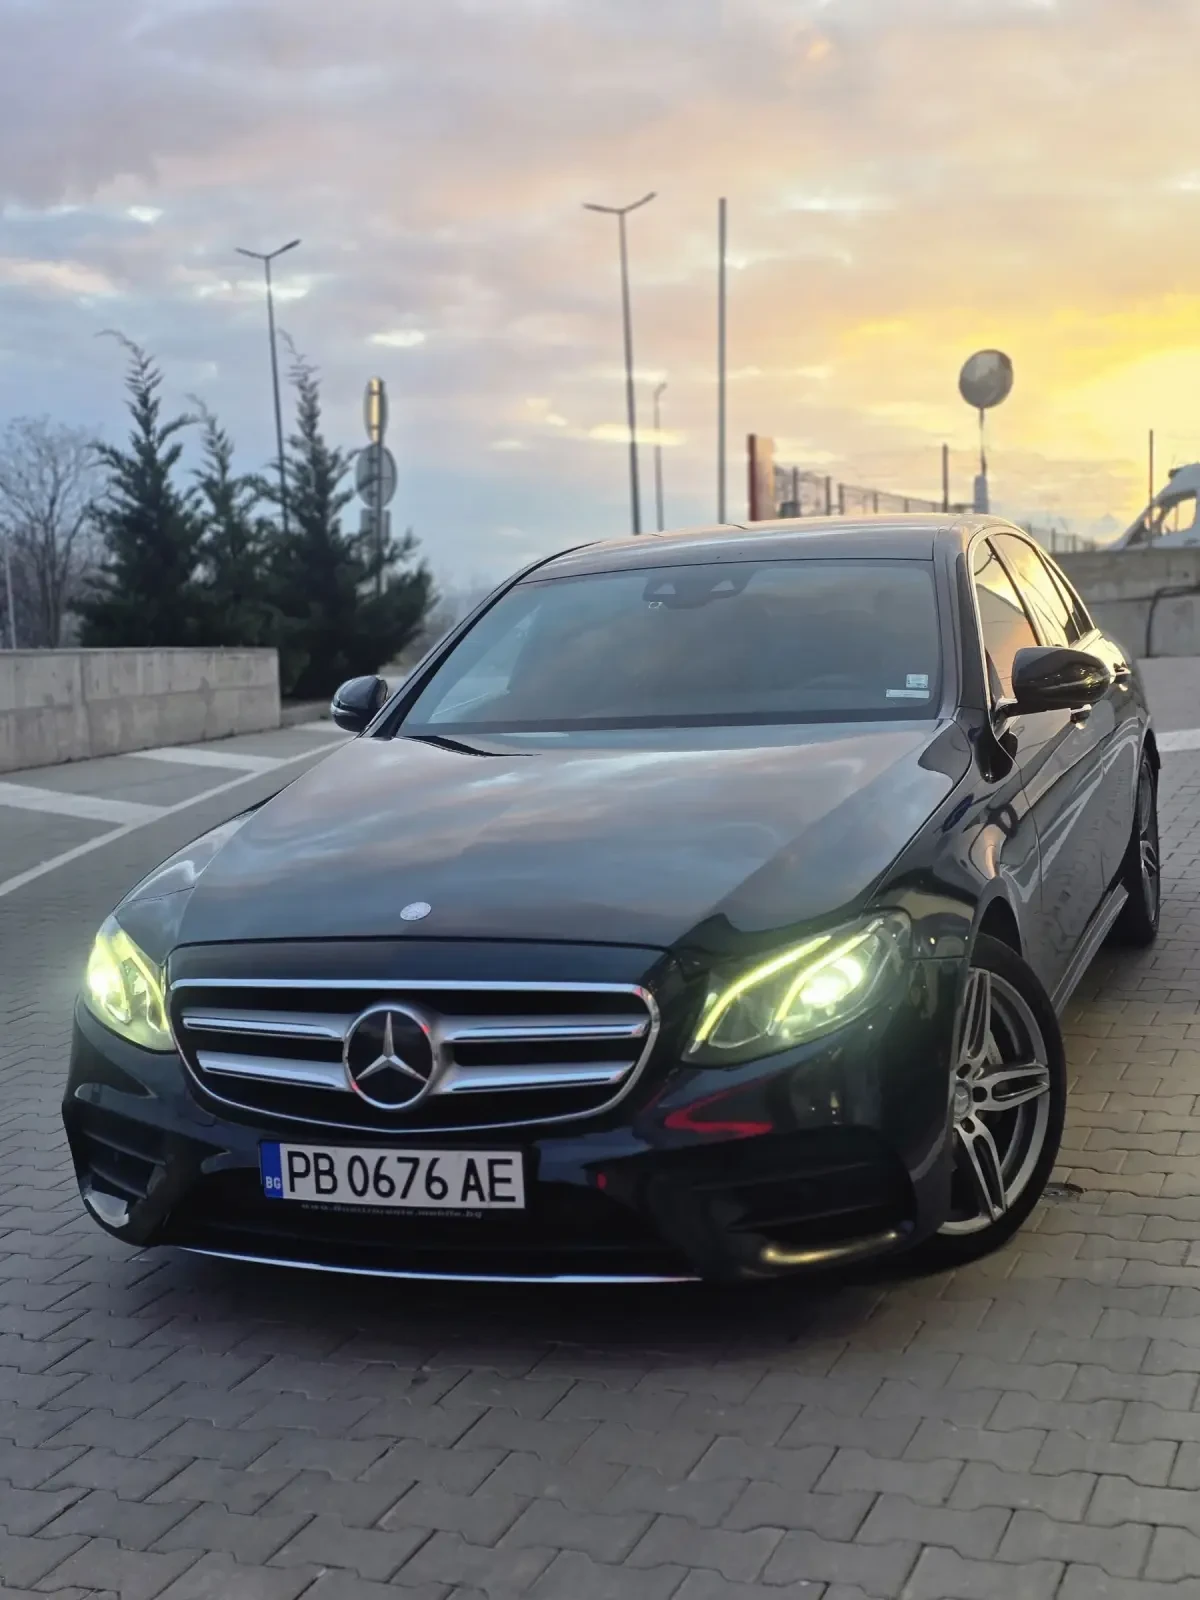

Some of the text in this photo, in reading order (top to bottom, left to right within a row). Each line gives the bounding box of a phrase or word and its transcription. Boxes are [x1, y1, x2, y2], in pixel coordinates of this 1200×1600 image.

[265, 1176, 281, 1189] BG
[287, 1150, 516, 1203] PB 0676 AE
